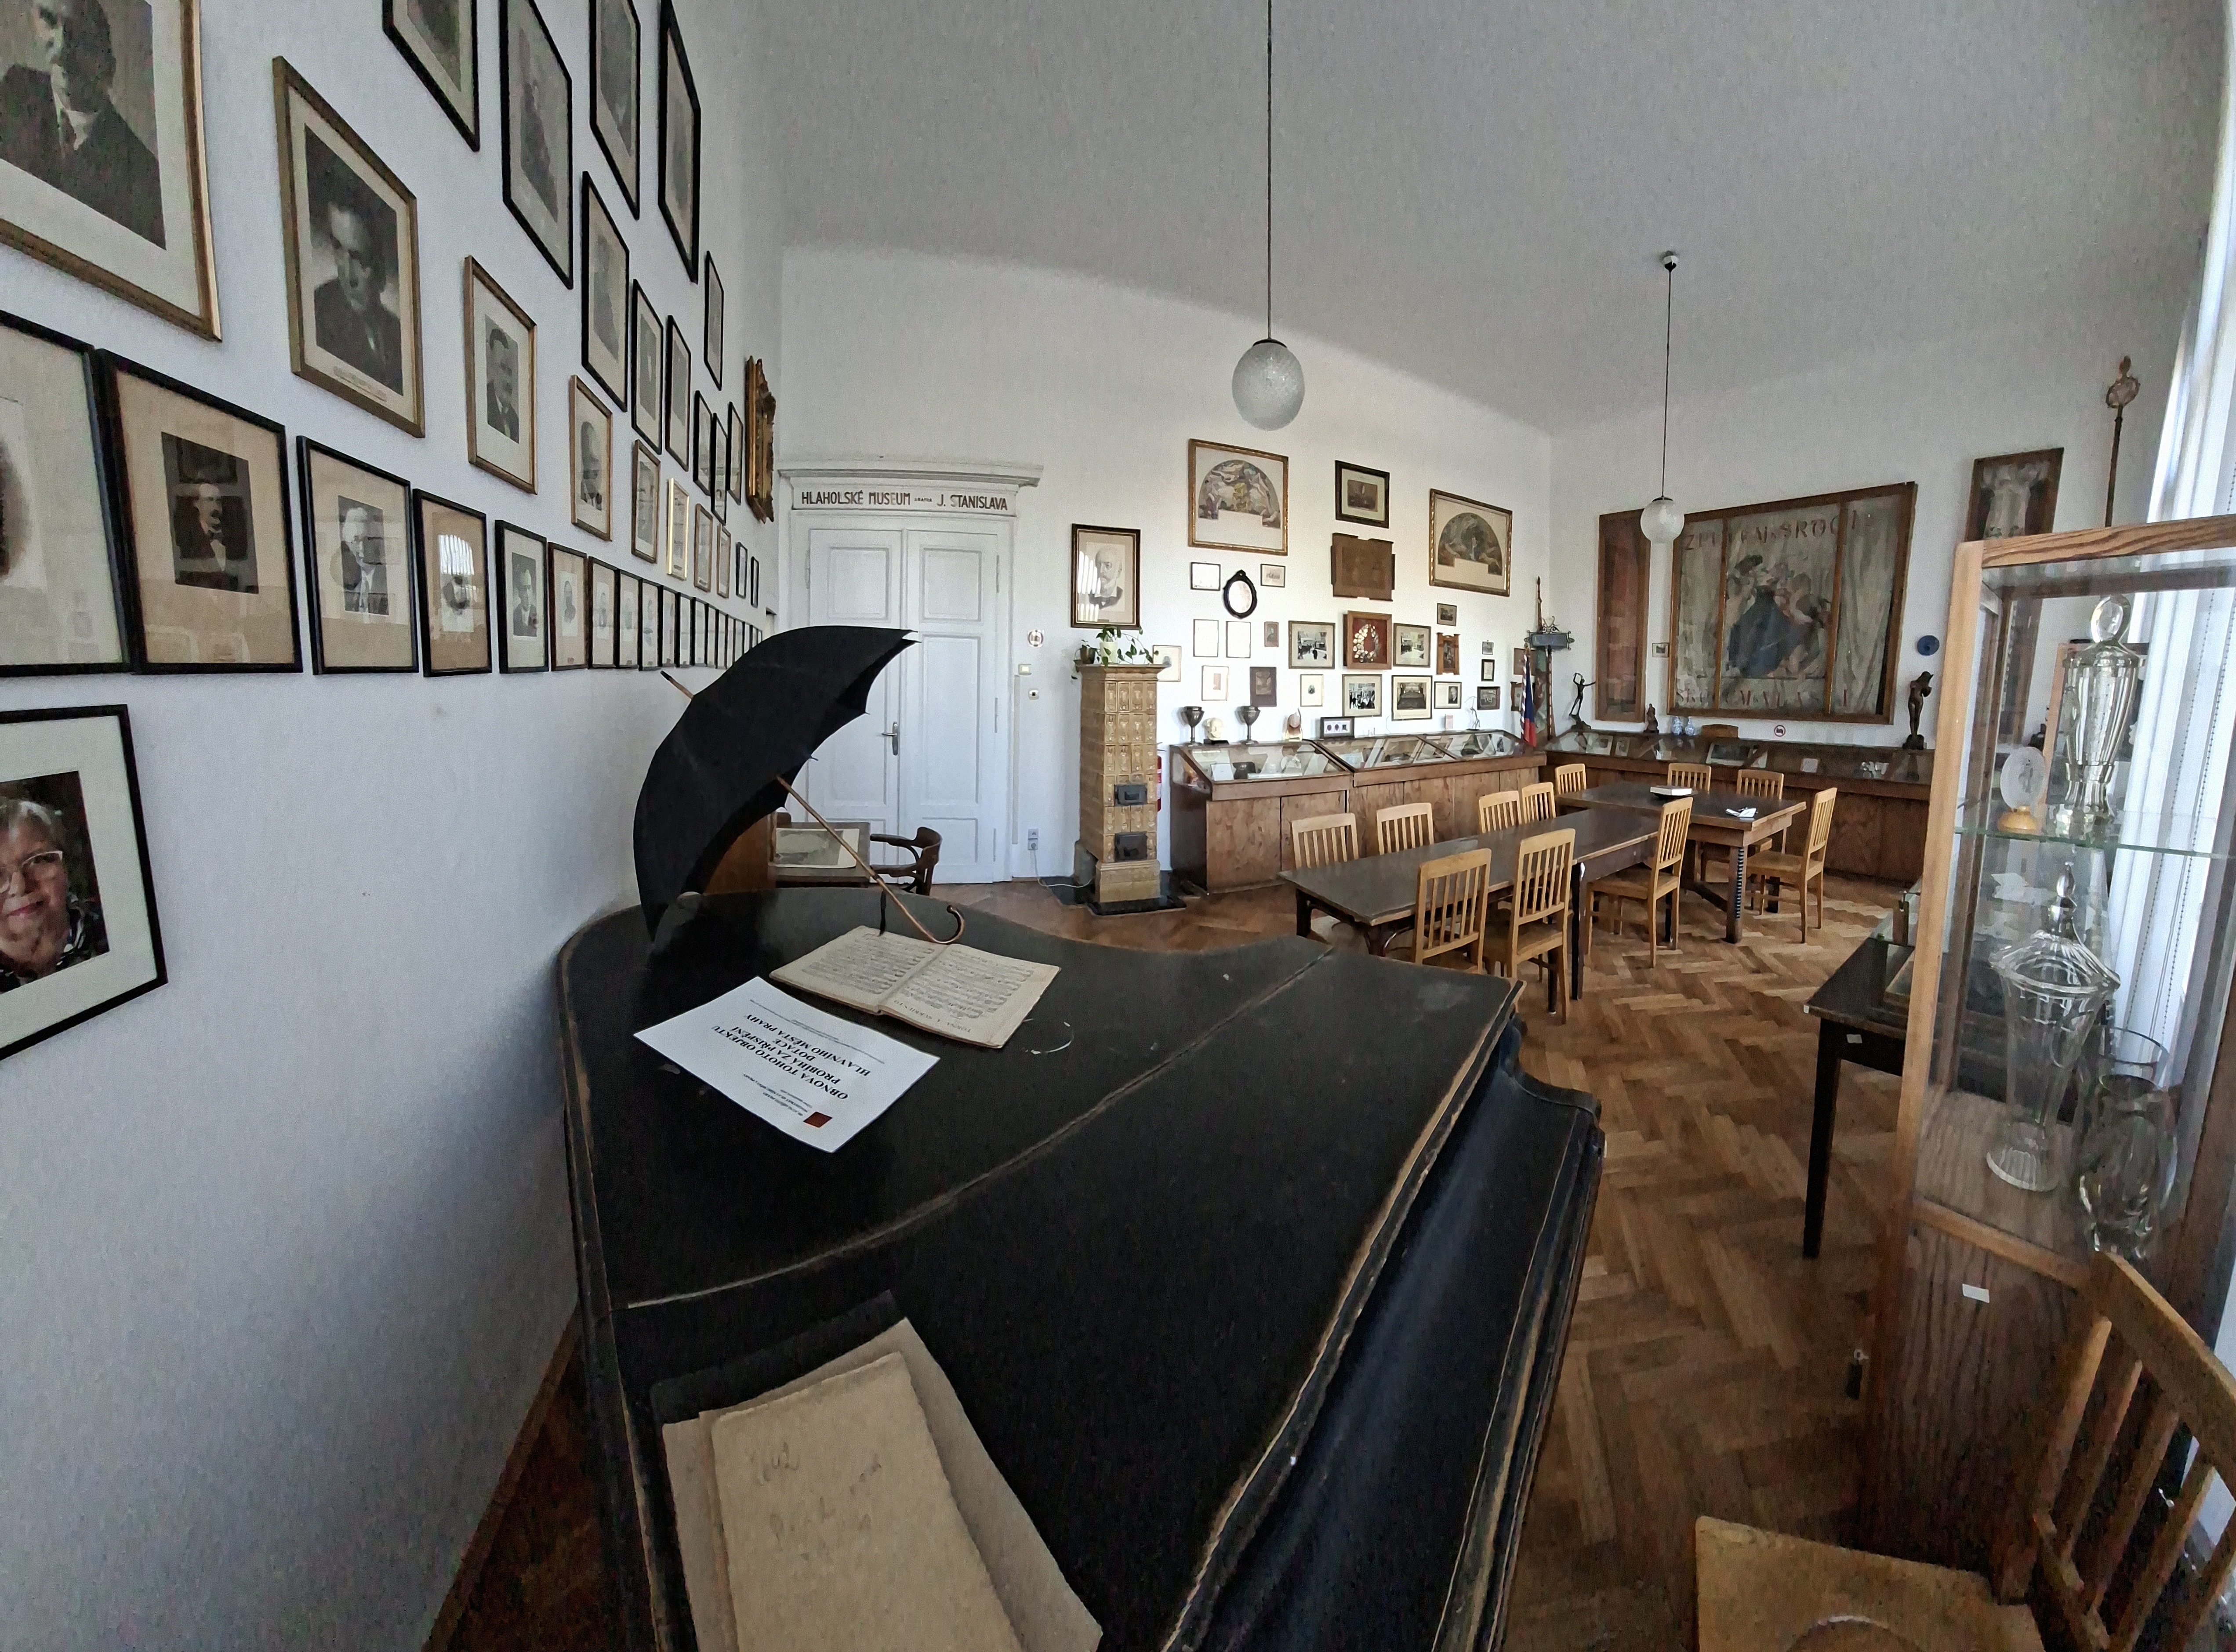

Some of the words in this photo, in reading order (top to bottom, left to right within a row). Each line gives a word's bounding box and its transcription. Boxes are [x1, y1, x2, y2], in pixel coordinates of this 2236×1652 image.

[801, 489, 864, 505] HLAHOLSKÉ
[868, 491, 911, 506] MUSEUM
[936, 493, 946, 507] J.
[950, 494, 1008, 511] STANISLAVA
[743, 1014, 778, 1032] PRAHY
[711, 1025, 756, 1051] OBJEKTU
[729, 1026, 777, 1051] PŘISPĚNÍ
[772, 1038, 816, 1061] DOTACE
[777, 1030, 812, 1049] MĚSTA
[755, 1049, 799, 1076] TOHOTO
[776, 1049, 792, 1060] ZA
[810, 1047, 871, 1076] HLAVNÍHO
[789, 1057, 842, 1084] PROBÍHÁ
[800, 1072, 848, 1099] OBNOVA
